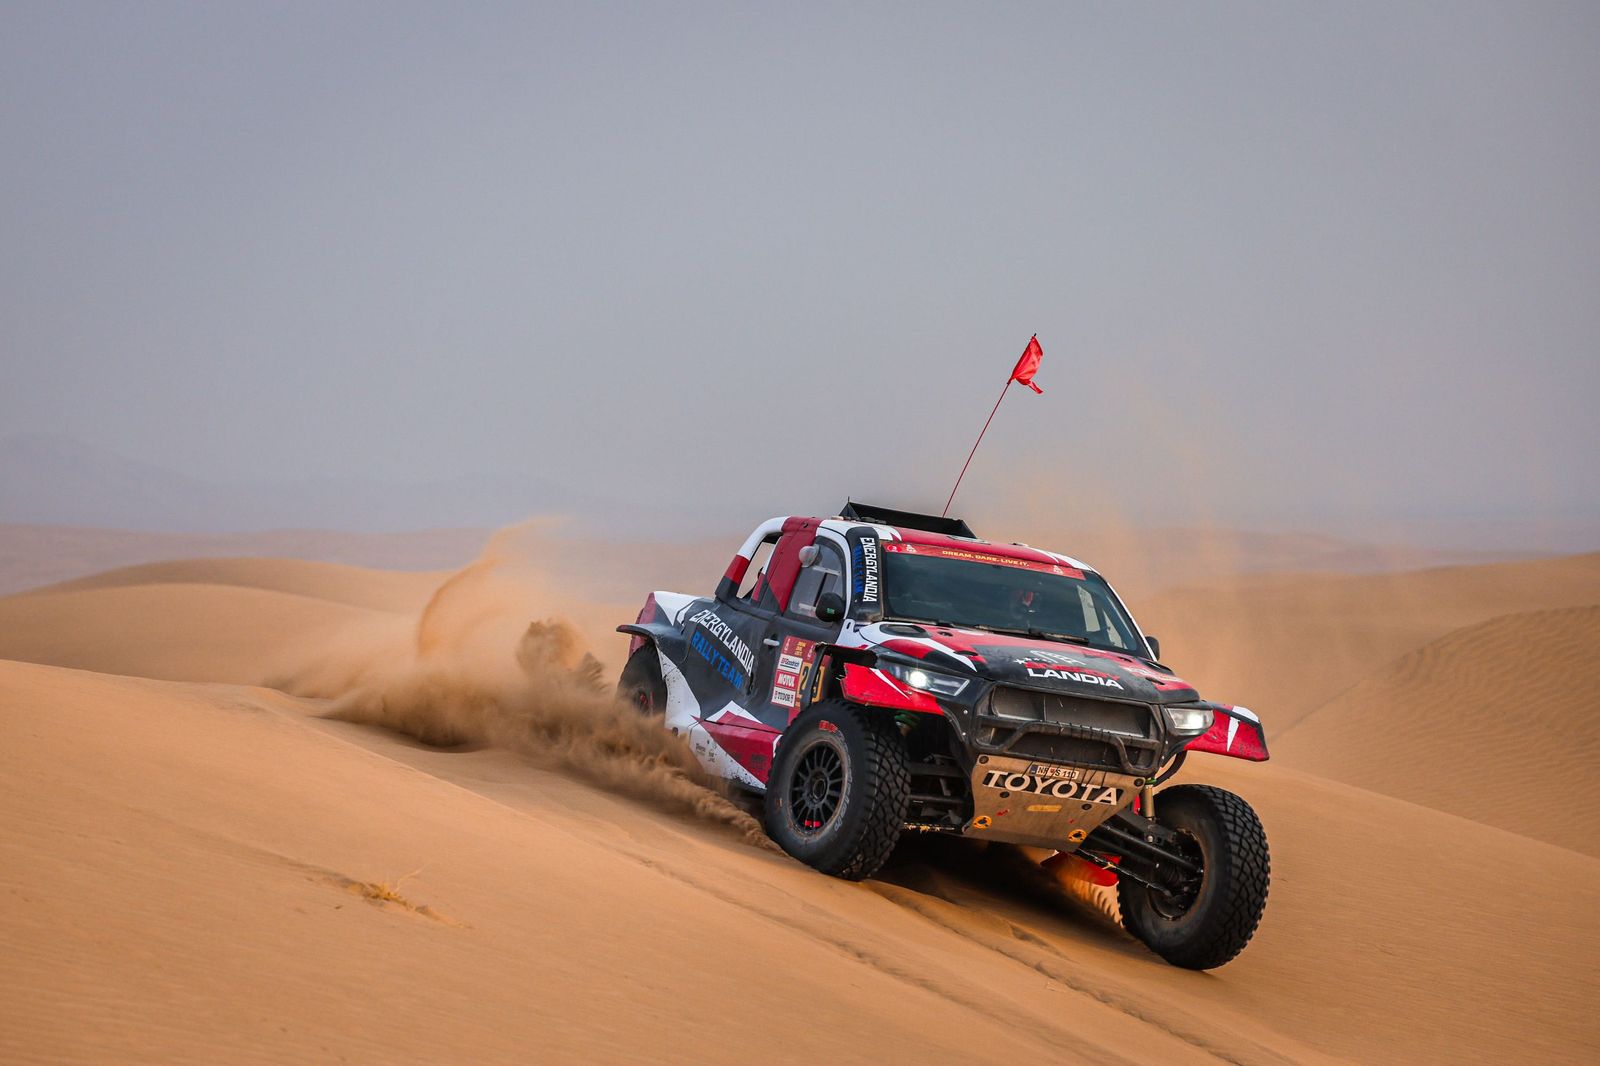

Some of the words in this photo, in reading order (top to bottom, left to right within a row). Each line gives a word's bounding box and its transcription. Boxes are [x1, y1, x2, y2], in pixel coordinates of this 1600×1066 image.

[860, 537, 878, 602] ENERGYLANDIA
[942, 550, 974, 559] DREAM.
[689, 609, 755, 677] ENERGYLANDIA
[691, 631, 718, 668] RALLY
[716, 655, 744, 690] TEAM
[777, 673, 796, 688] MOTUL
[1027, 668, 1124, 690] LANDIA
[986, 770, 1117, 805] TOYOTA
